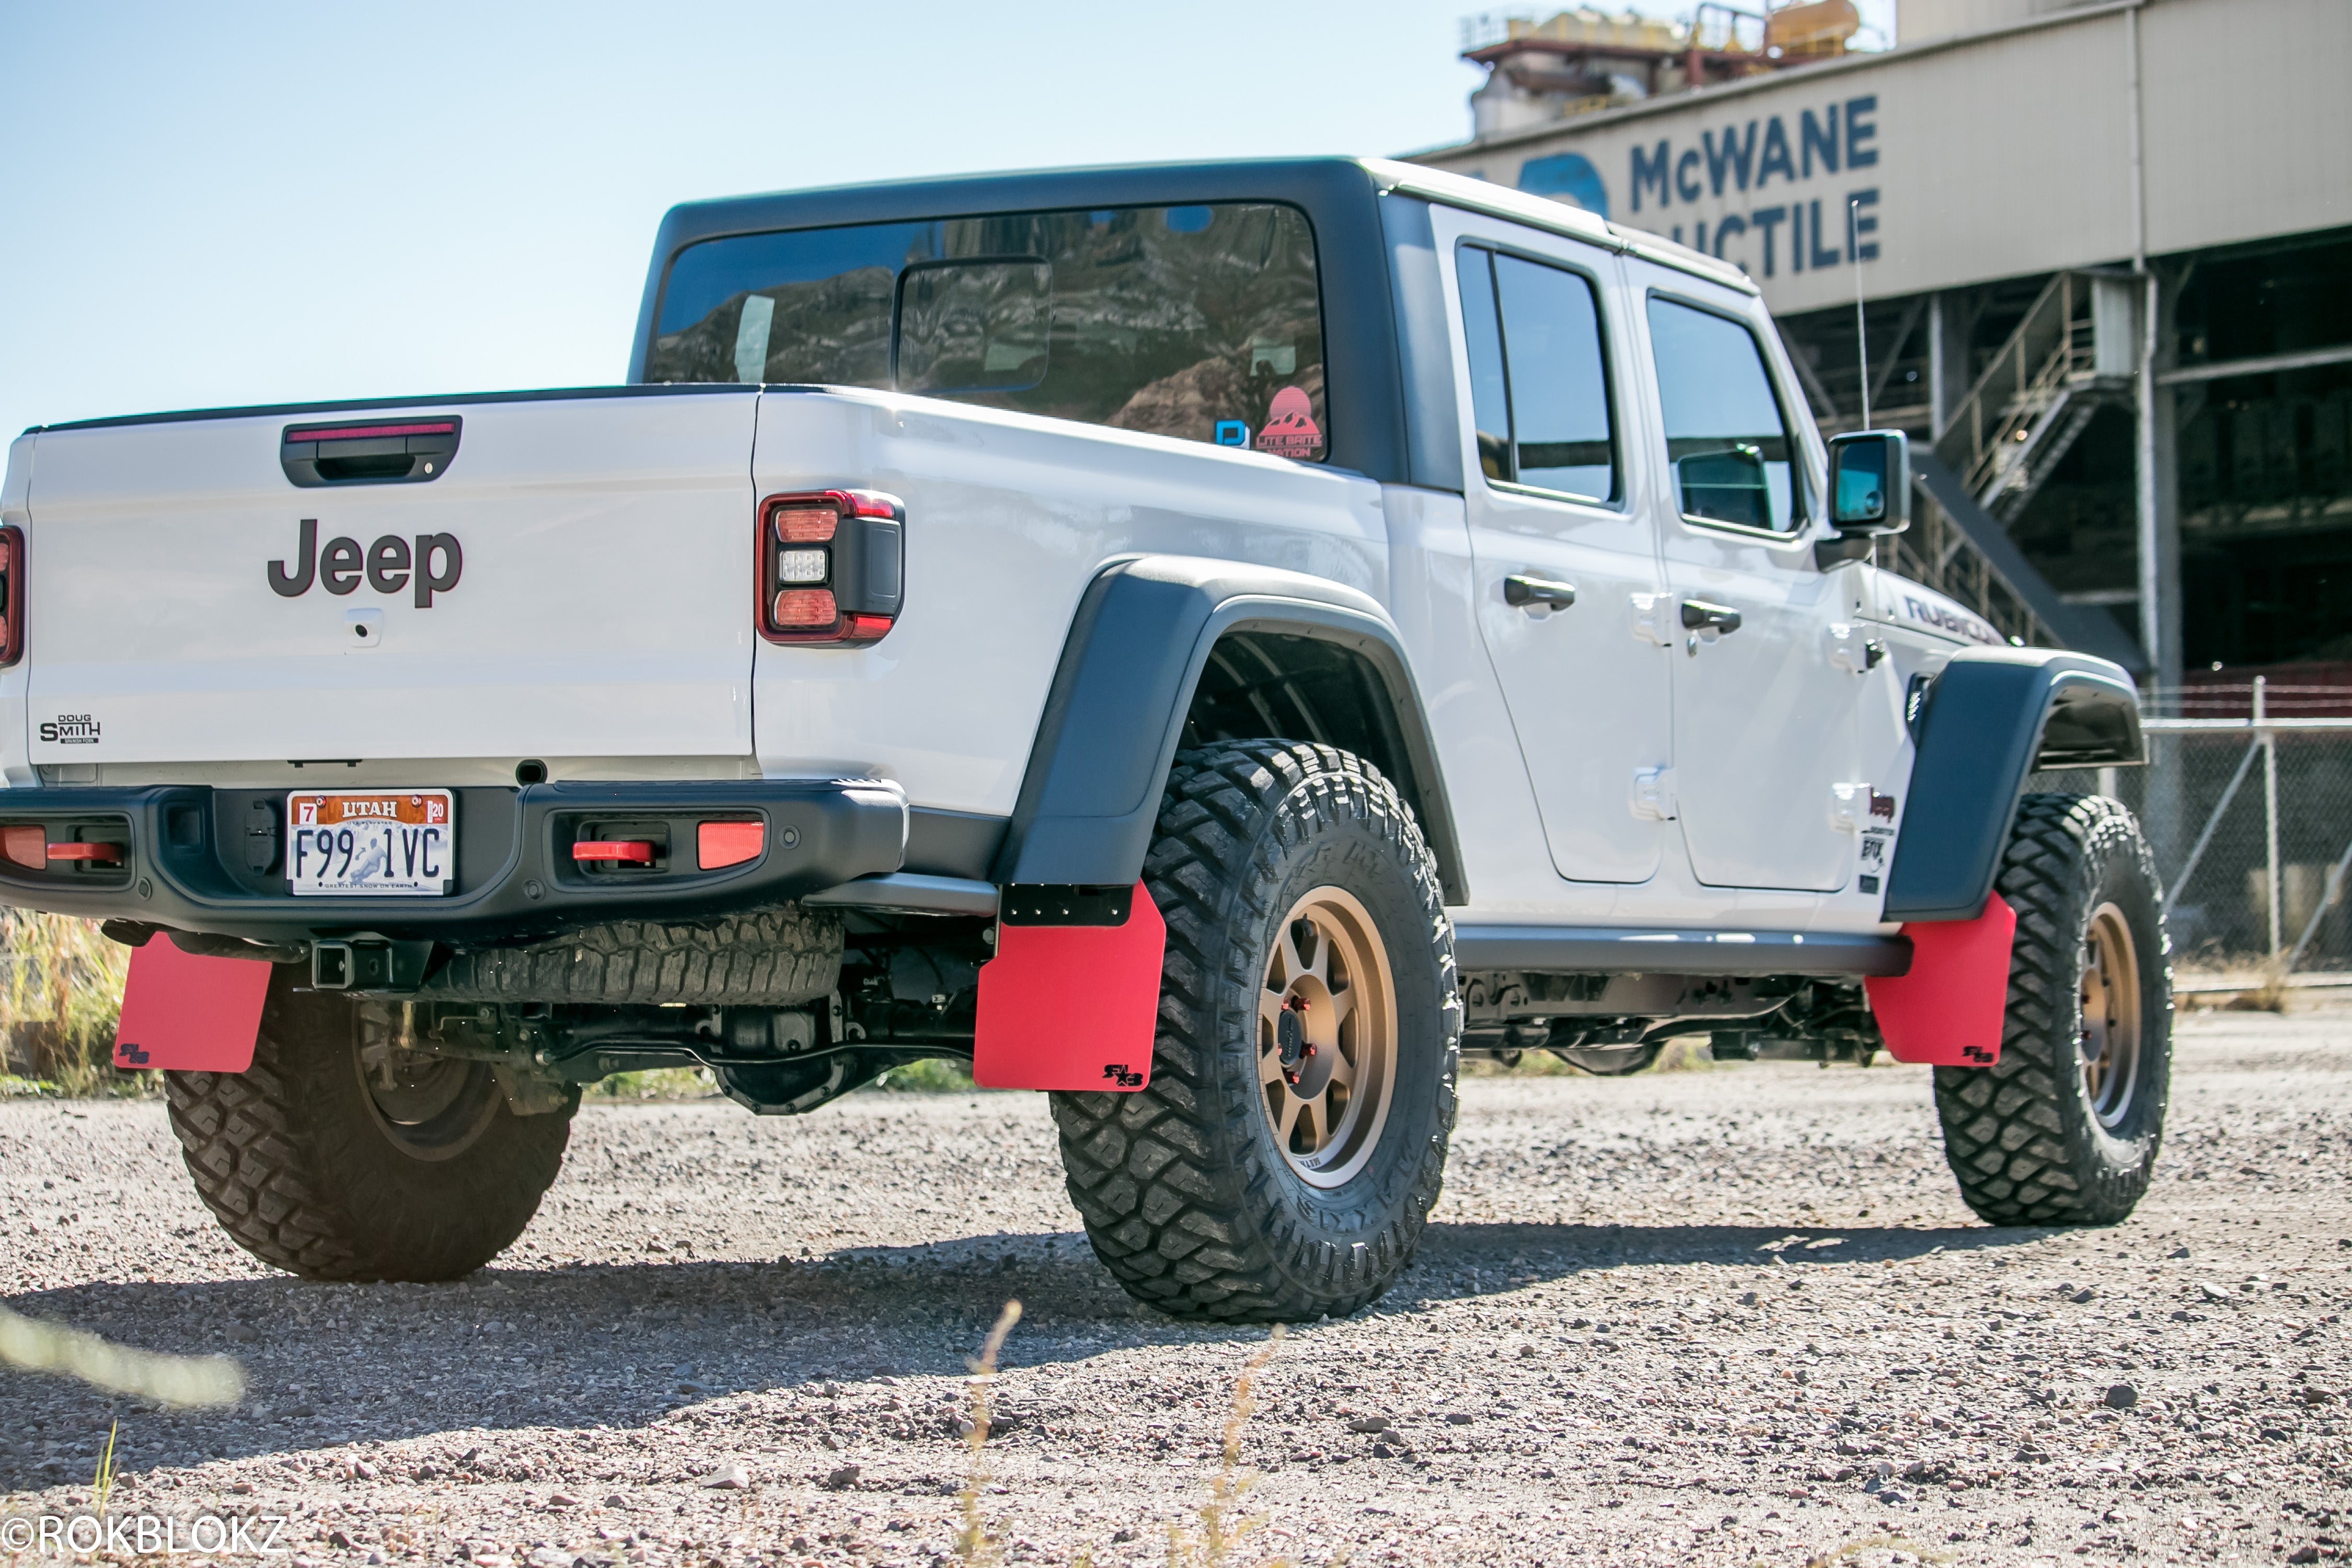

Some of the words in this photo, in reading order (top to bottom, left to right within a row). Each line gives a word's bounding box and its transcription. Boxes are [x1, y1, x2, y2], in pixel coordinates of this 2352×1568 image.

[1630, 95, 1879, 213] McWANE
[1657, 187, 1880, 278] CTILE
[268, 518, 463, 608] Jeep
[40, 722, 101, 742] SMITH
[303, 806, 314, 822] 7
[342, 801, 398, 818] UTAH
[433, 803, 444, 817] 20
[296, 829, 354, 878] F99
[383, 828, 440, 878] 1VC
